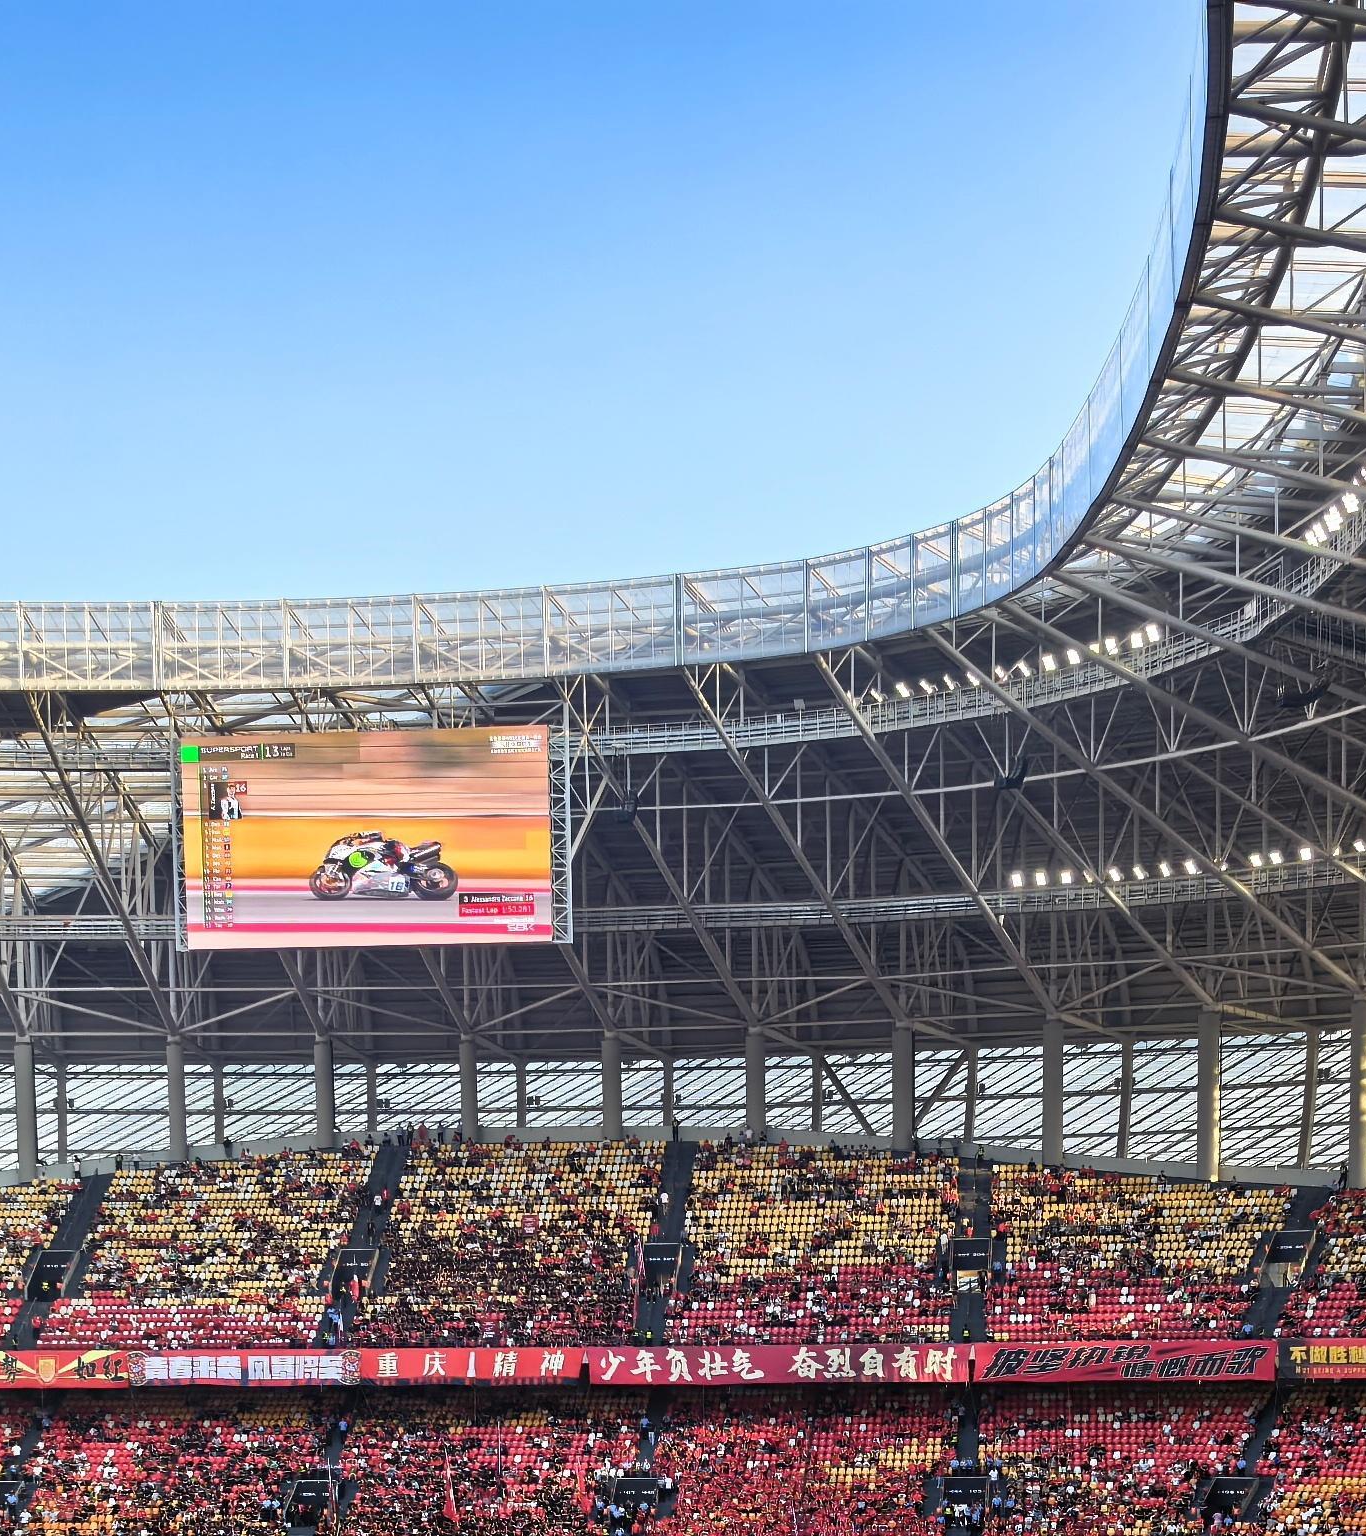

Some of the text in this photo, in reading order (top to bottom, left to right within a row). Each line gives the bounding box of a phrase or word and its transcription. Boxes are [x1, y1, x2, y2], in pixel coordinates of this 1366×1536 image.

[200, 745, 280, 758] SUPERSPORT 13
[235, 783, 246, 792] 16
